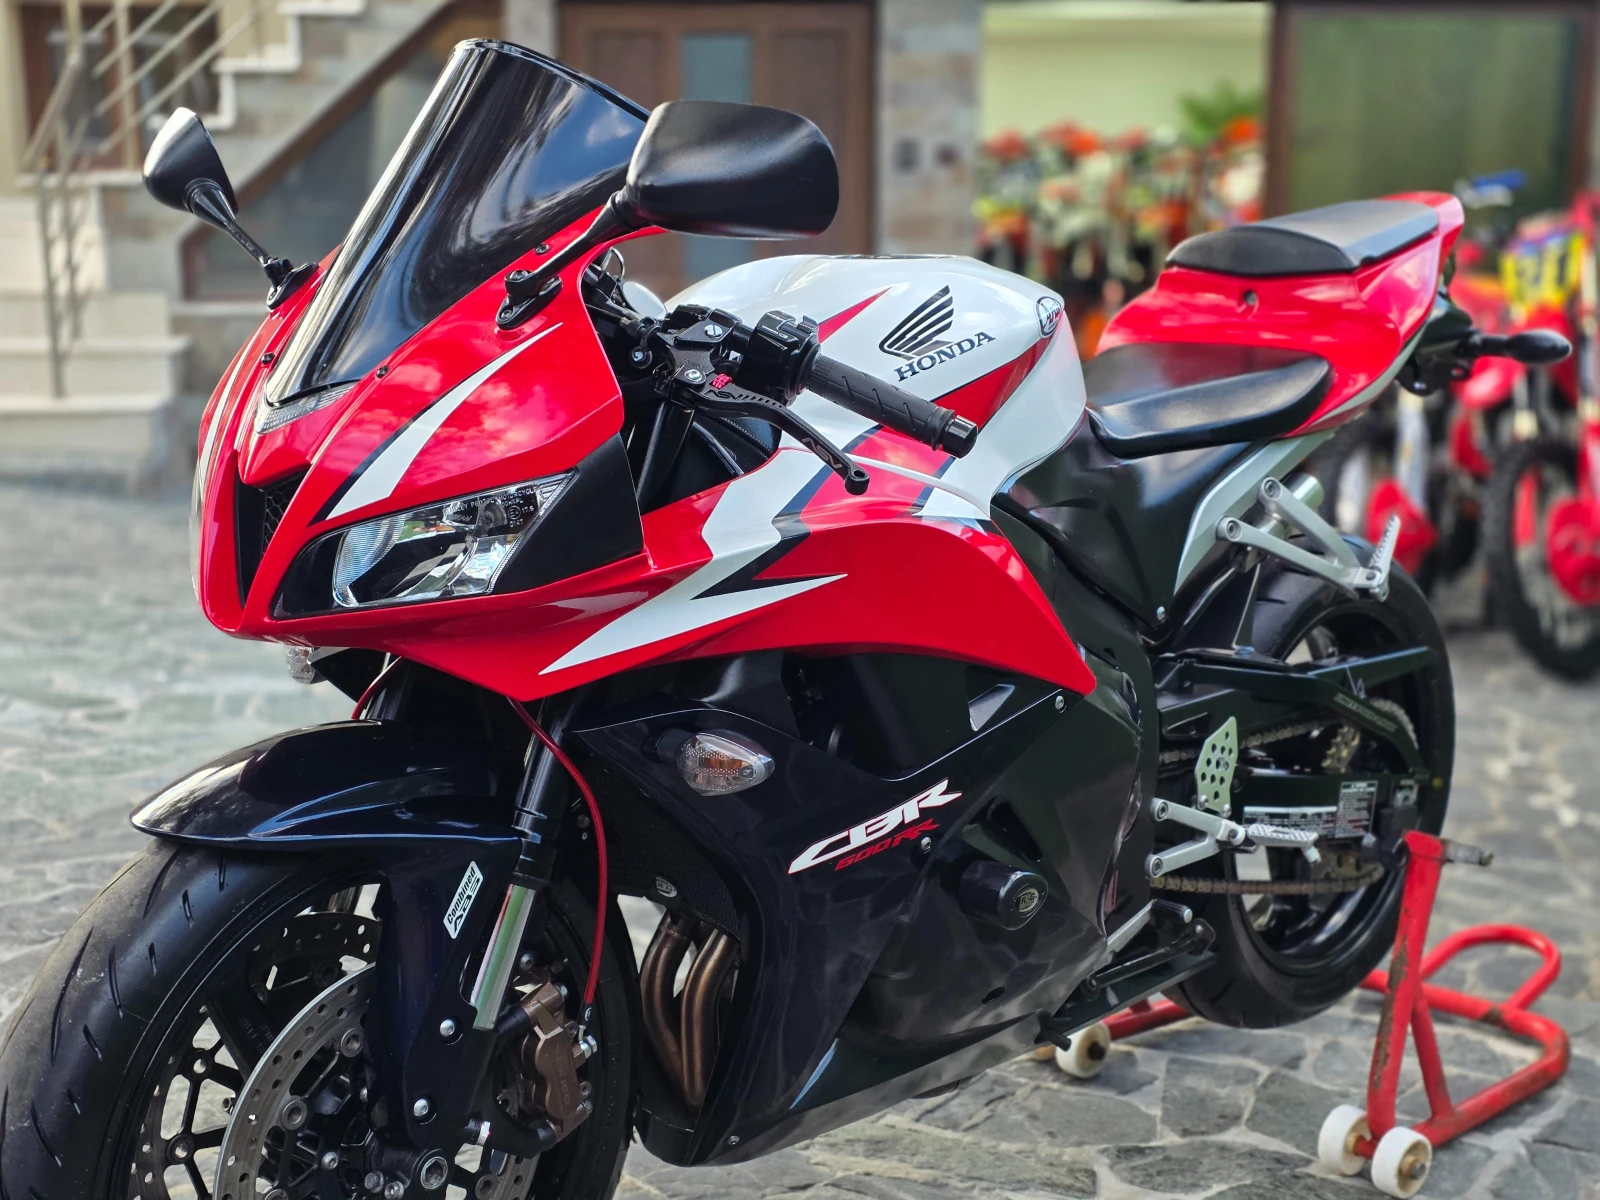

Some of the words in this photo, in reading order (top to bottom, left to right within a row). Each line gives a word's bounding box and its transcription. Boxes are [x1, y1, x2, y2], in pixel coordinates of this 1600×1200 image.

[893, 331, 996, 382] HONDA
[704, 389, 744, 400] ASV
[801, 437, 843, 469] ASV
[787, 777, 963, 875] CBR
[447, 866, 476, 925] Combined
